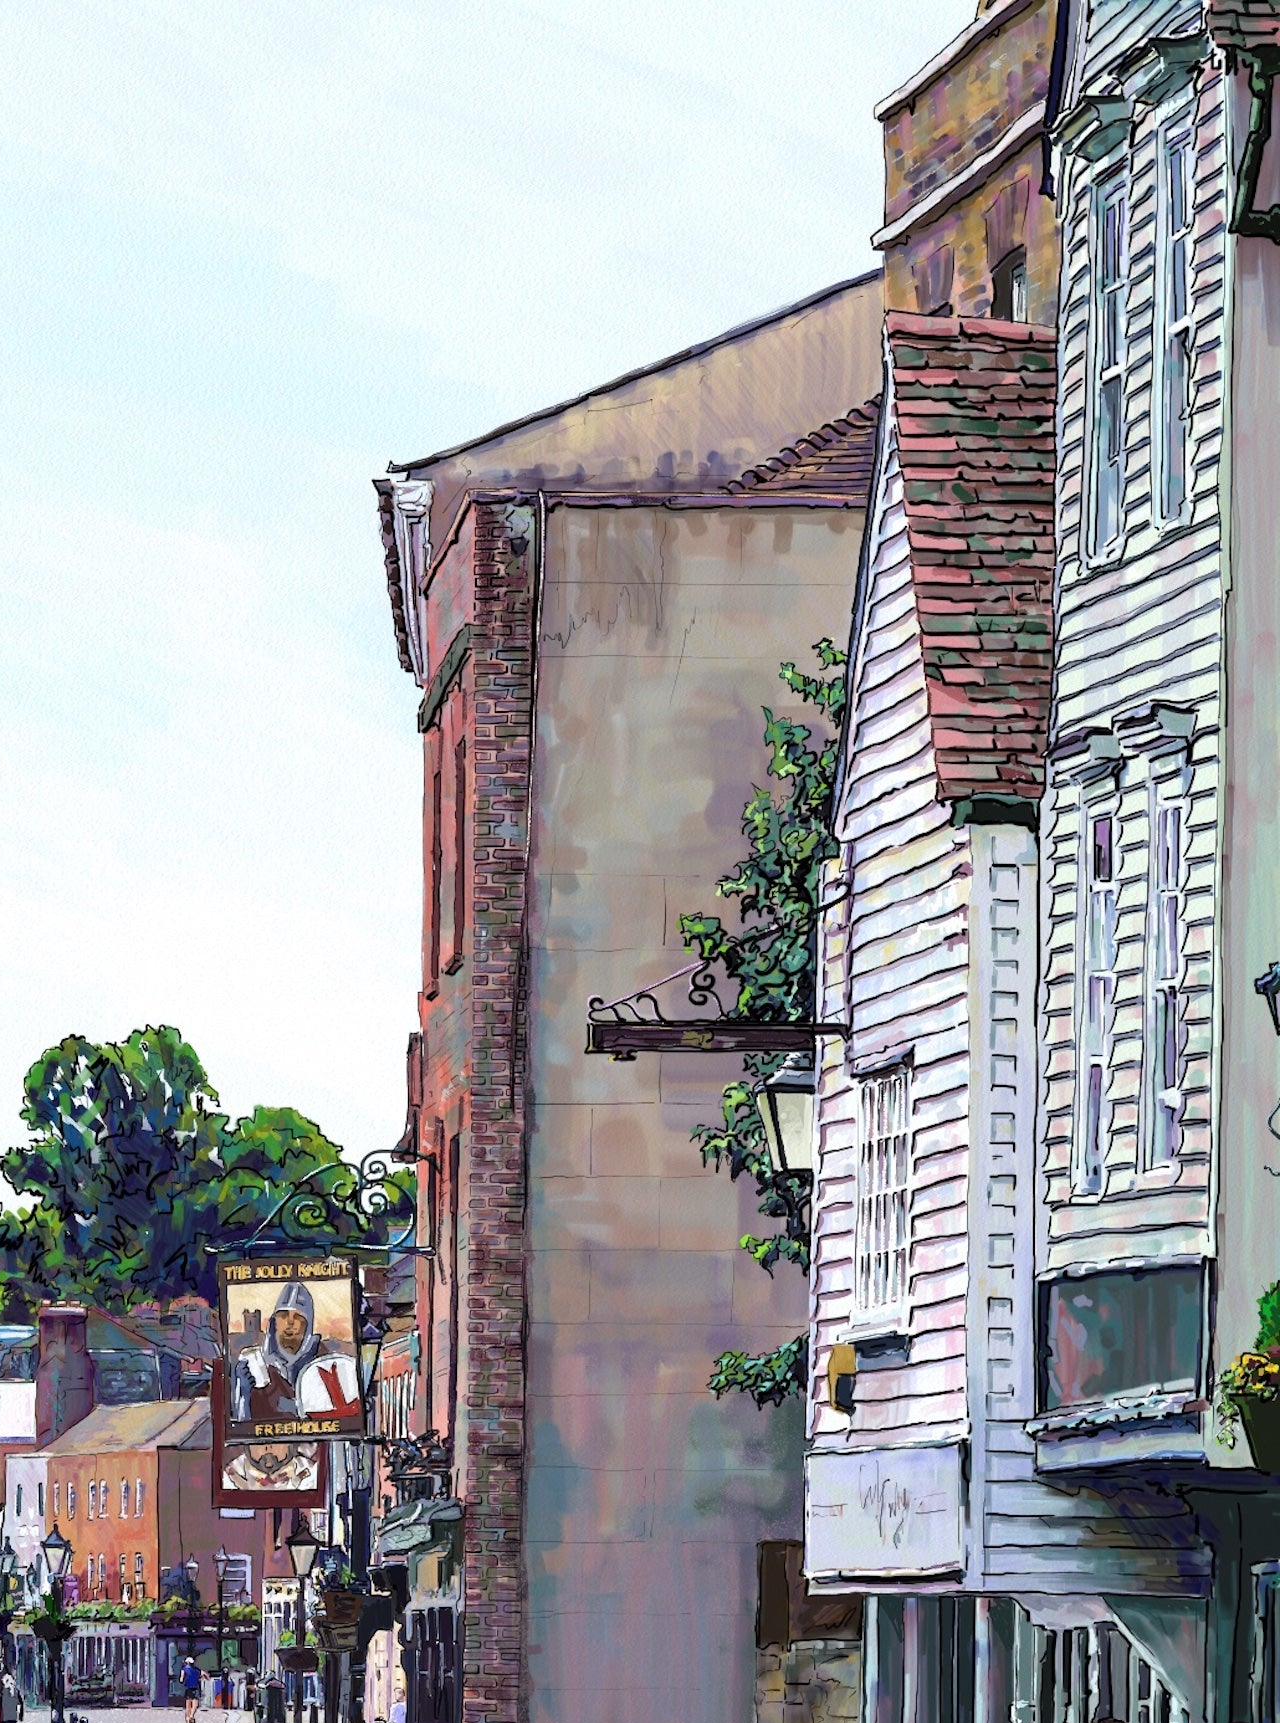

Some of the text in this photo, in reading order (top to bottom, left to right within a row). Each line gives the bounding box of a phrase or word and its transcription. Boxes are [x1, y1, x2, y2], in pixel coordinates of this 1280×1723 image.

[224, 1260, 352, 1280] THE JOLLY KNIGHT
